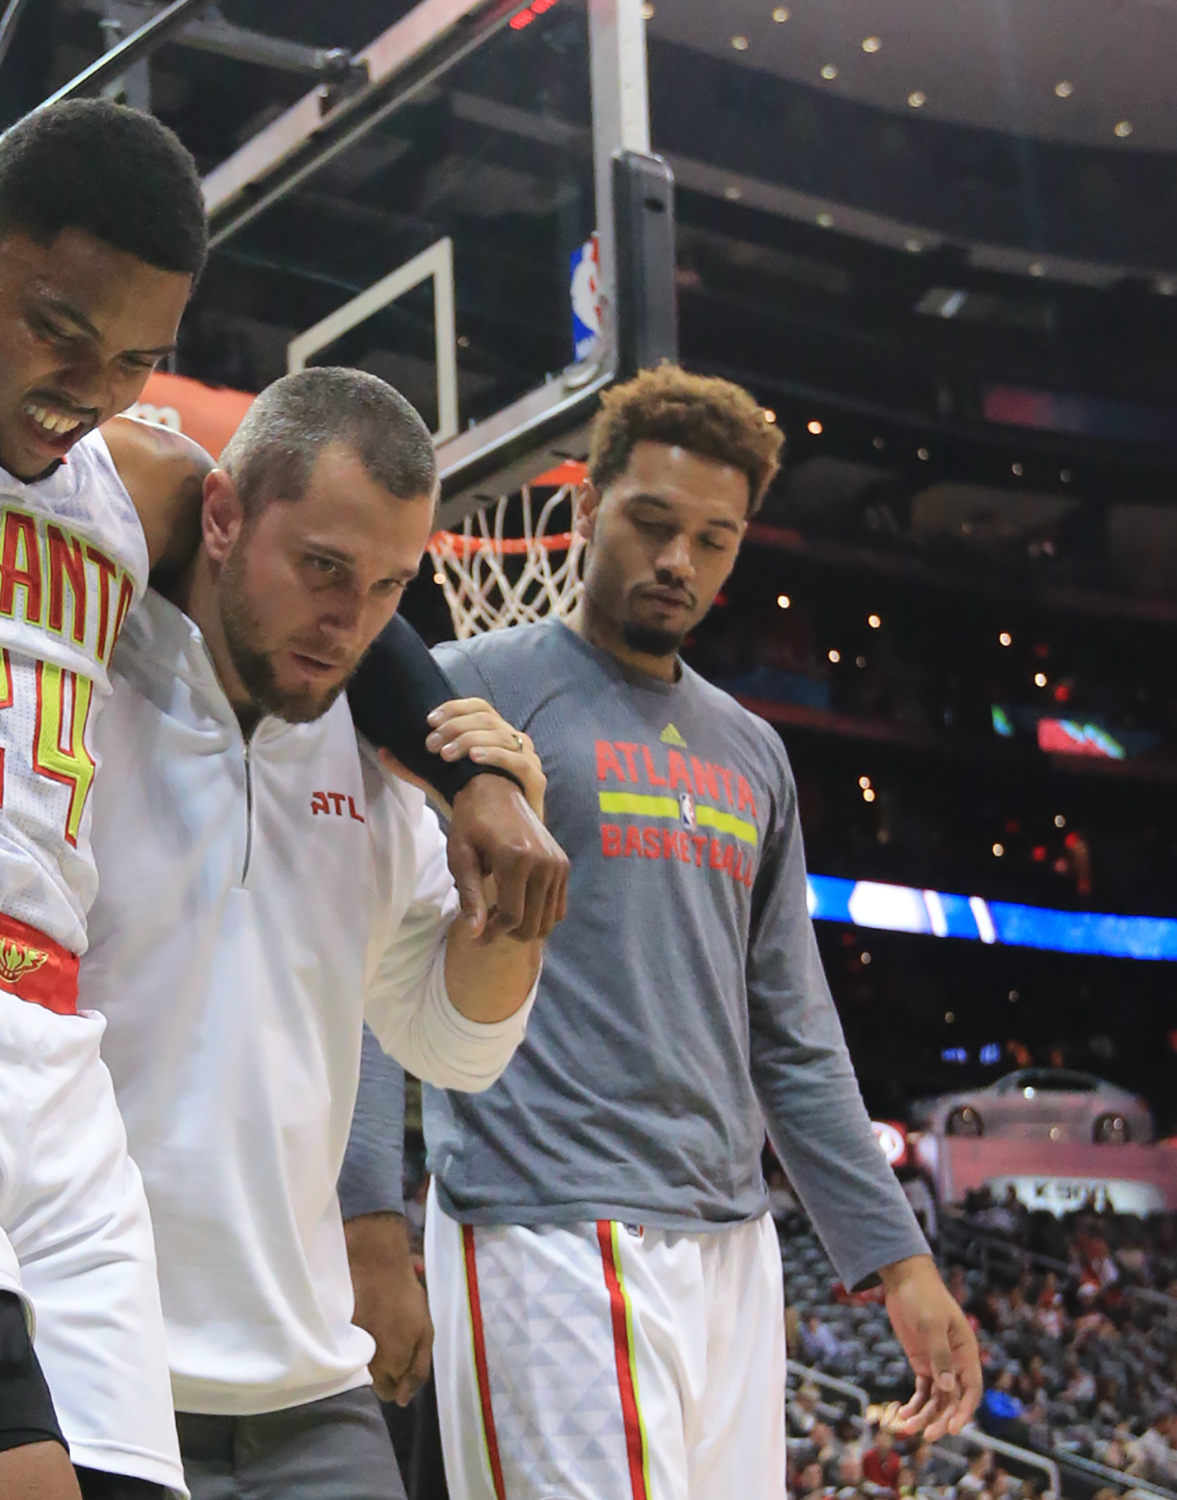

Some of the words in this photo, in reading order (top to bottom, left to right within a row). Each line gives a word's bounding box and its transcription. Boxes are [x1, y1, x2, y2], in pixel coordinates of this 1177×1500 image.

[311, 791, 365, 823] ATL
[595, 739, 758, 818] ATLANTA
[601, 822, 753, 888] BASKETBALL
